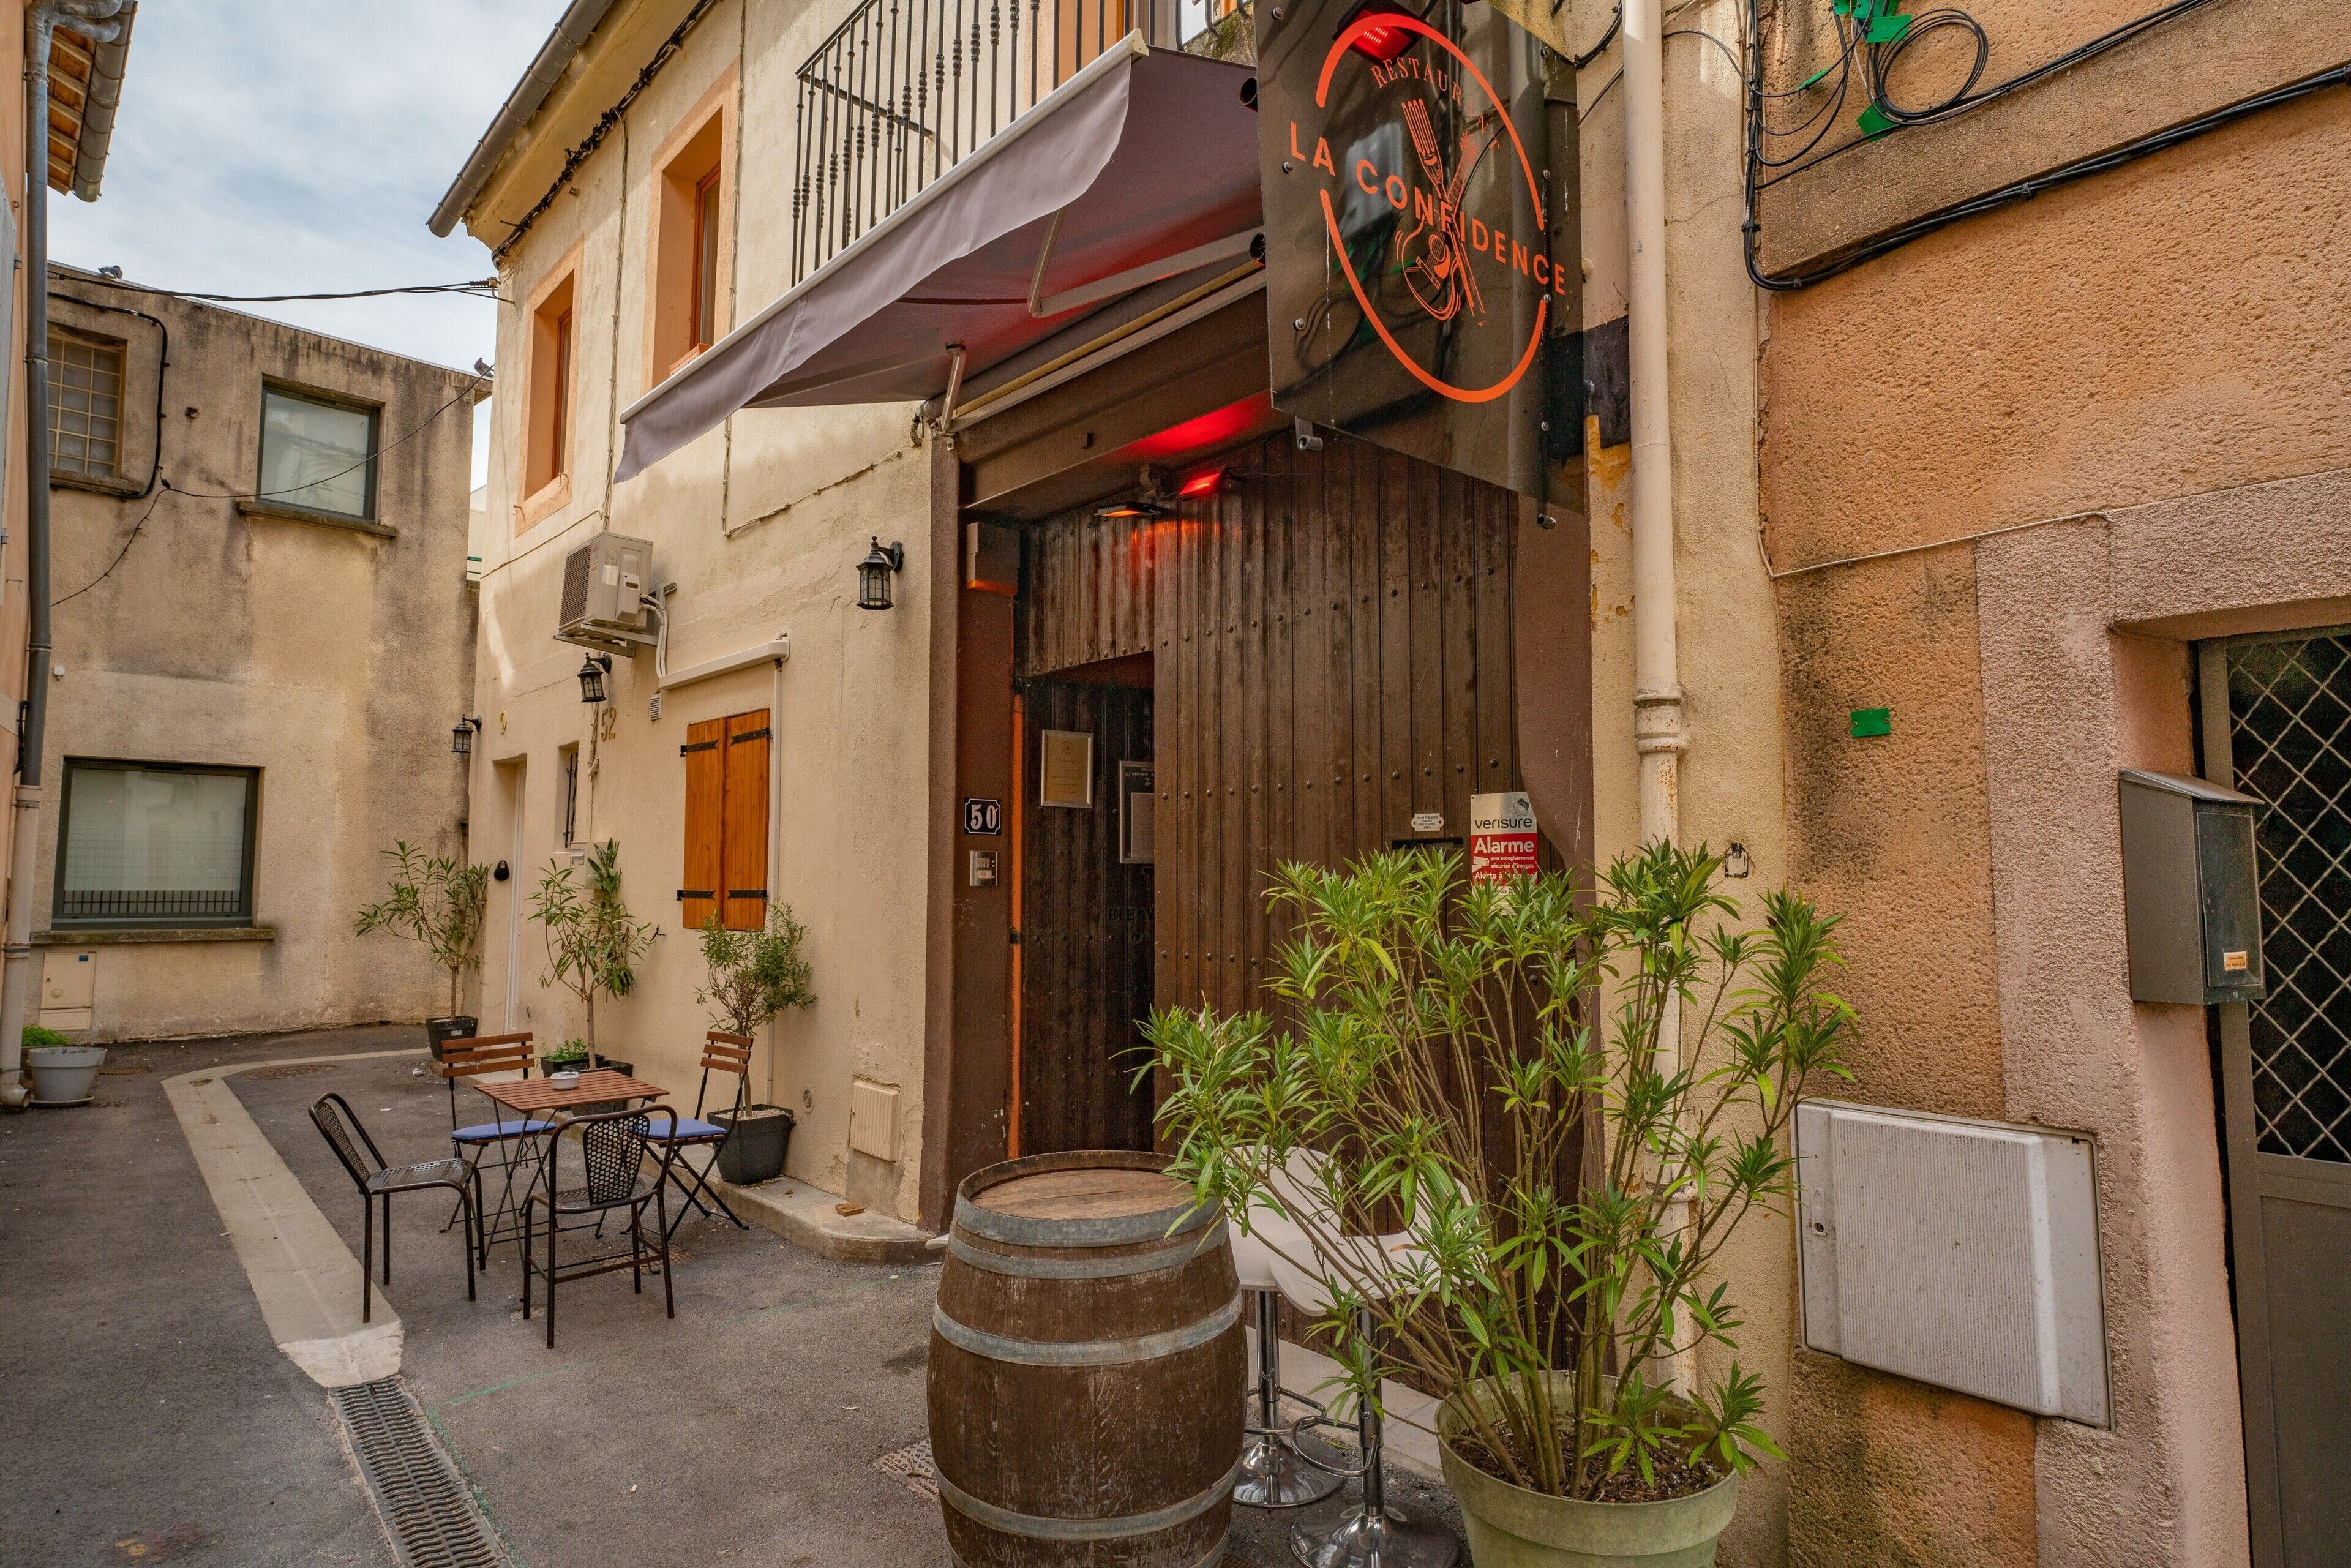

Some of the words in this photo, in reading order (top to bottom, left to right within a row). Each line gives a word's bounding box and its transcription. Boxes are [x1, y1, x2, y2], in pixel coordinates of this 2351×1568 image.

[1290, 121, 1335, 176] LA
[1356, 159, 1565, 295] CONFIDENCE
[601, 706, 617, 741] 52
[970, 804, 997, 830] 50
[1475, 817, 1532, 830] verisure
[1474, 836, 1534, 853] Alarme
